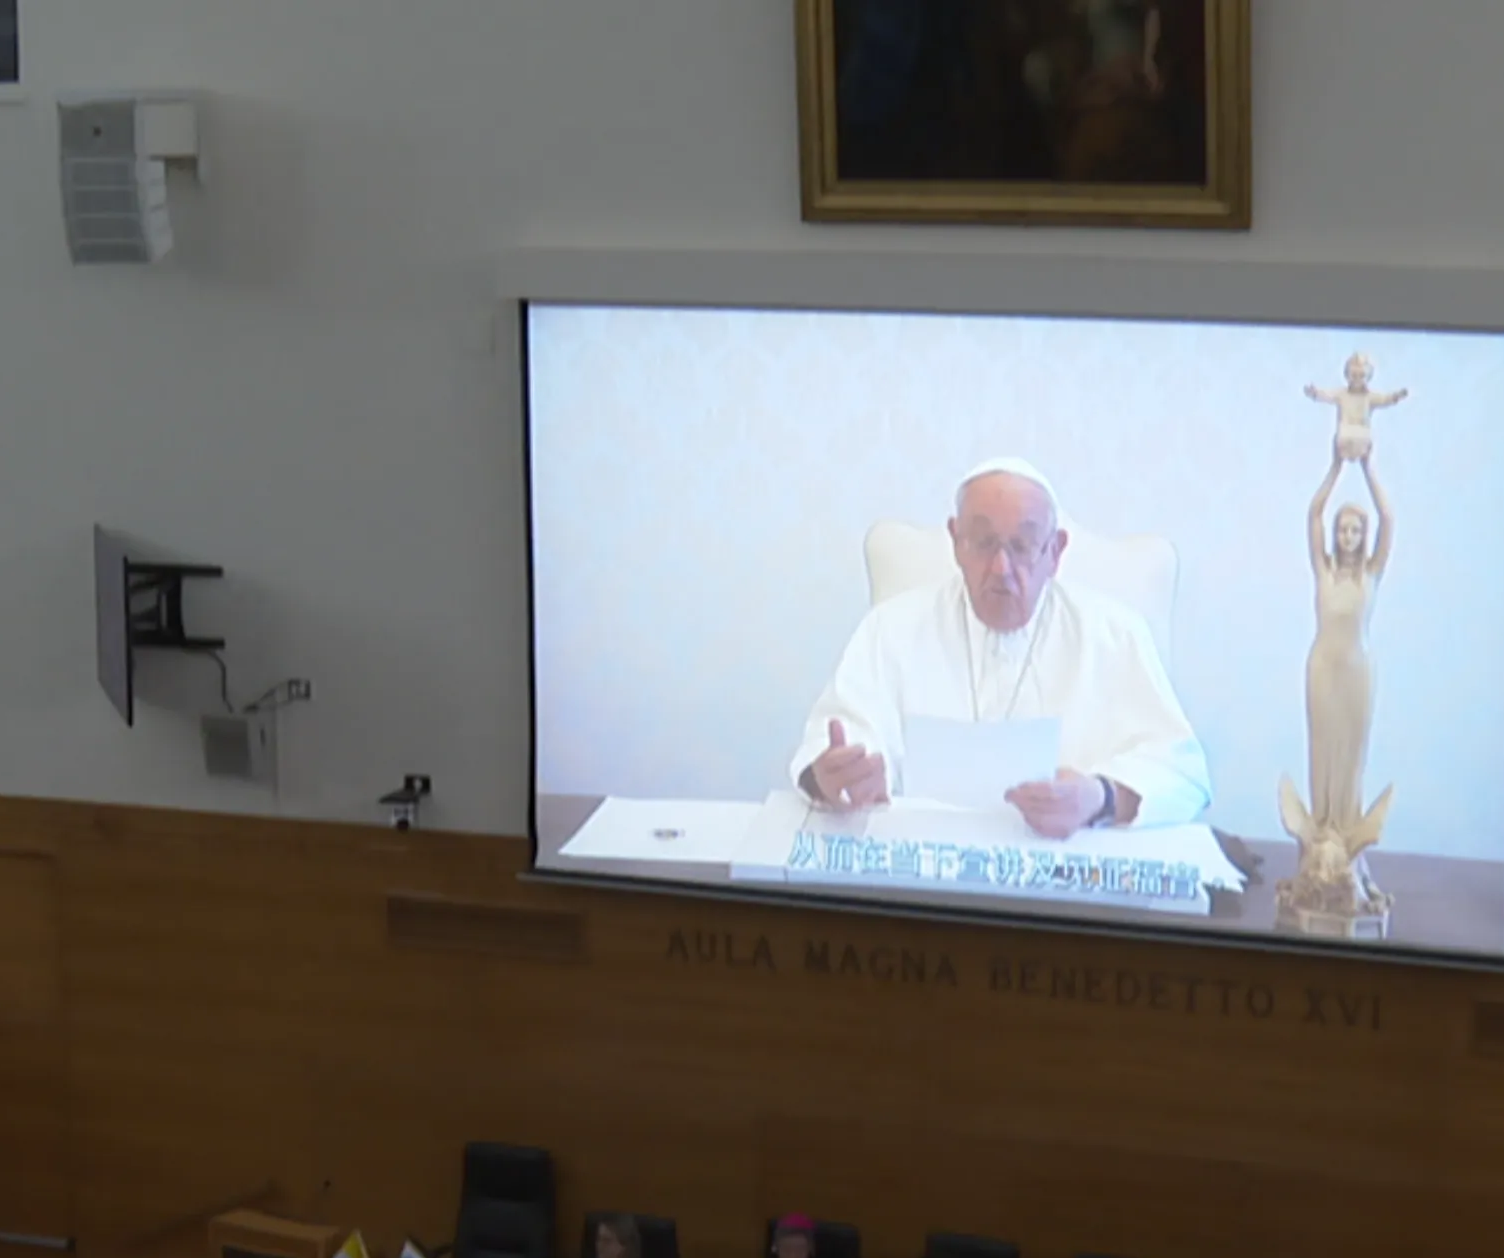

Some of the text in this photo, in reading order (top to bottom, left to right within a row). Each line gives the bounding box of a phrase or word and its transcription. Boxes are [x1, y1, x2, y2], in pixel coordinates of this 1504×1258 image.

[665, 927, 1384, 1031] AULA MAGNA BENEDETTO XVI
